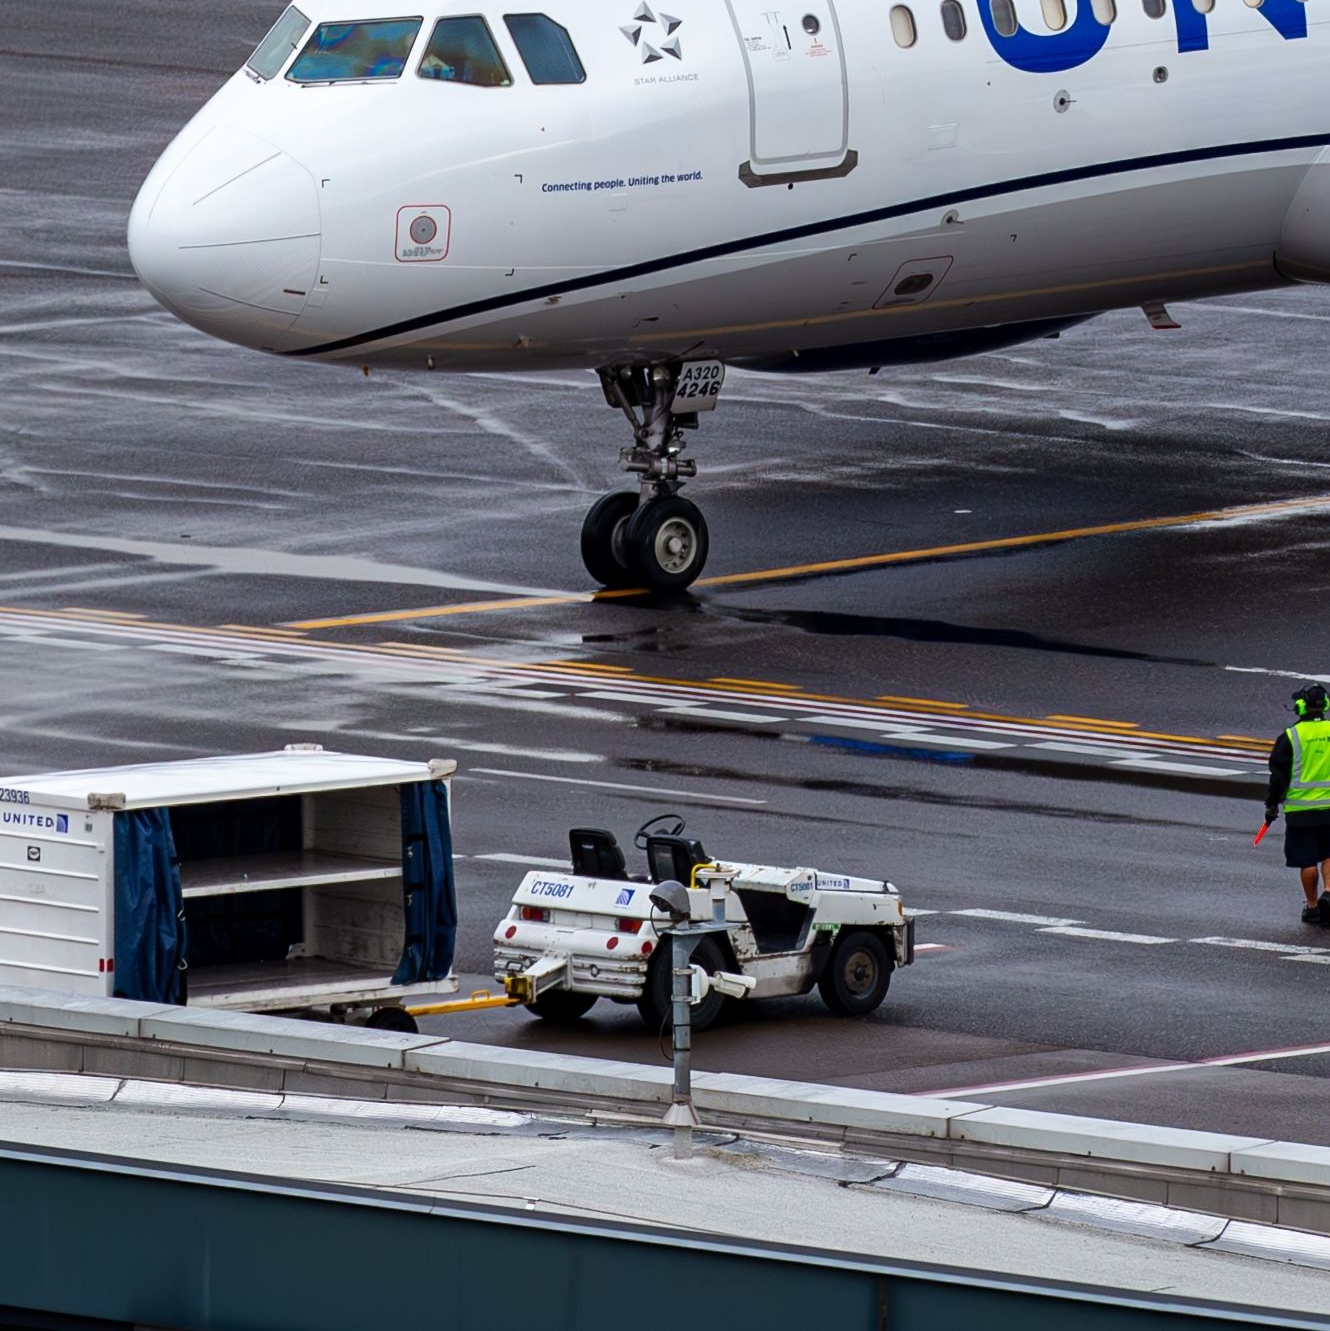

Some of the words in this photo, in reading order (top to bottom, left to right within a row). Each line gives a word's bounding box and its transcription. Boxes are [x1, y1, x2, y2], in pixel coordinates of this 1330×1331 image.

[633, 77, 656, 86] STAR
[659, 72, 699, 83] ALLIANCE
[541, 180, 592, 193] Connecting
[593, 178, 626, 190] people.
[628, 174, 659, 186] Uniting
[661, 173, 675, 184] the
[676, 170, 703, 182] world.
[683, 365, 720, 381] A320
[677, 380, 721, 398] 4246
[3, 812, 55, 828] UNITED
[530, 880, 575, 898] CT5081
[816, 879, 843, 887] UNITED
